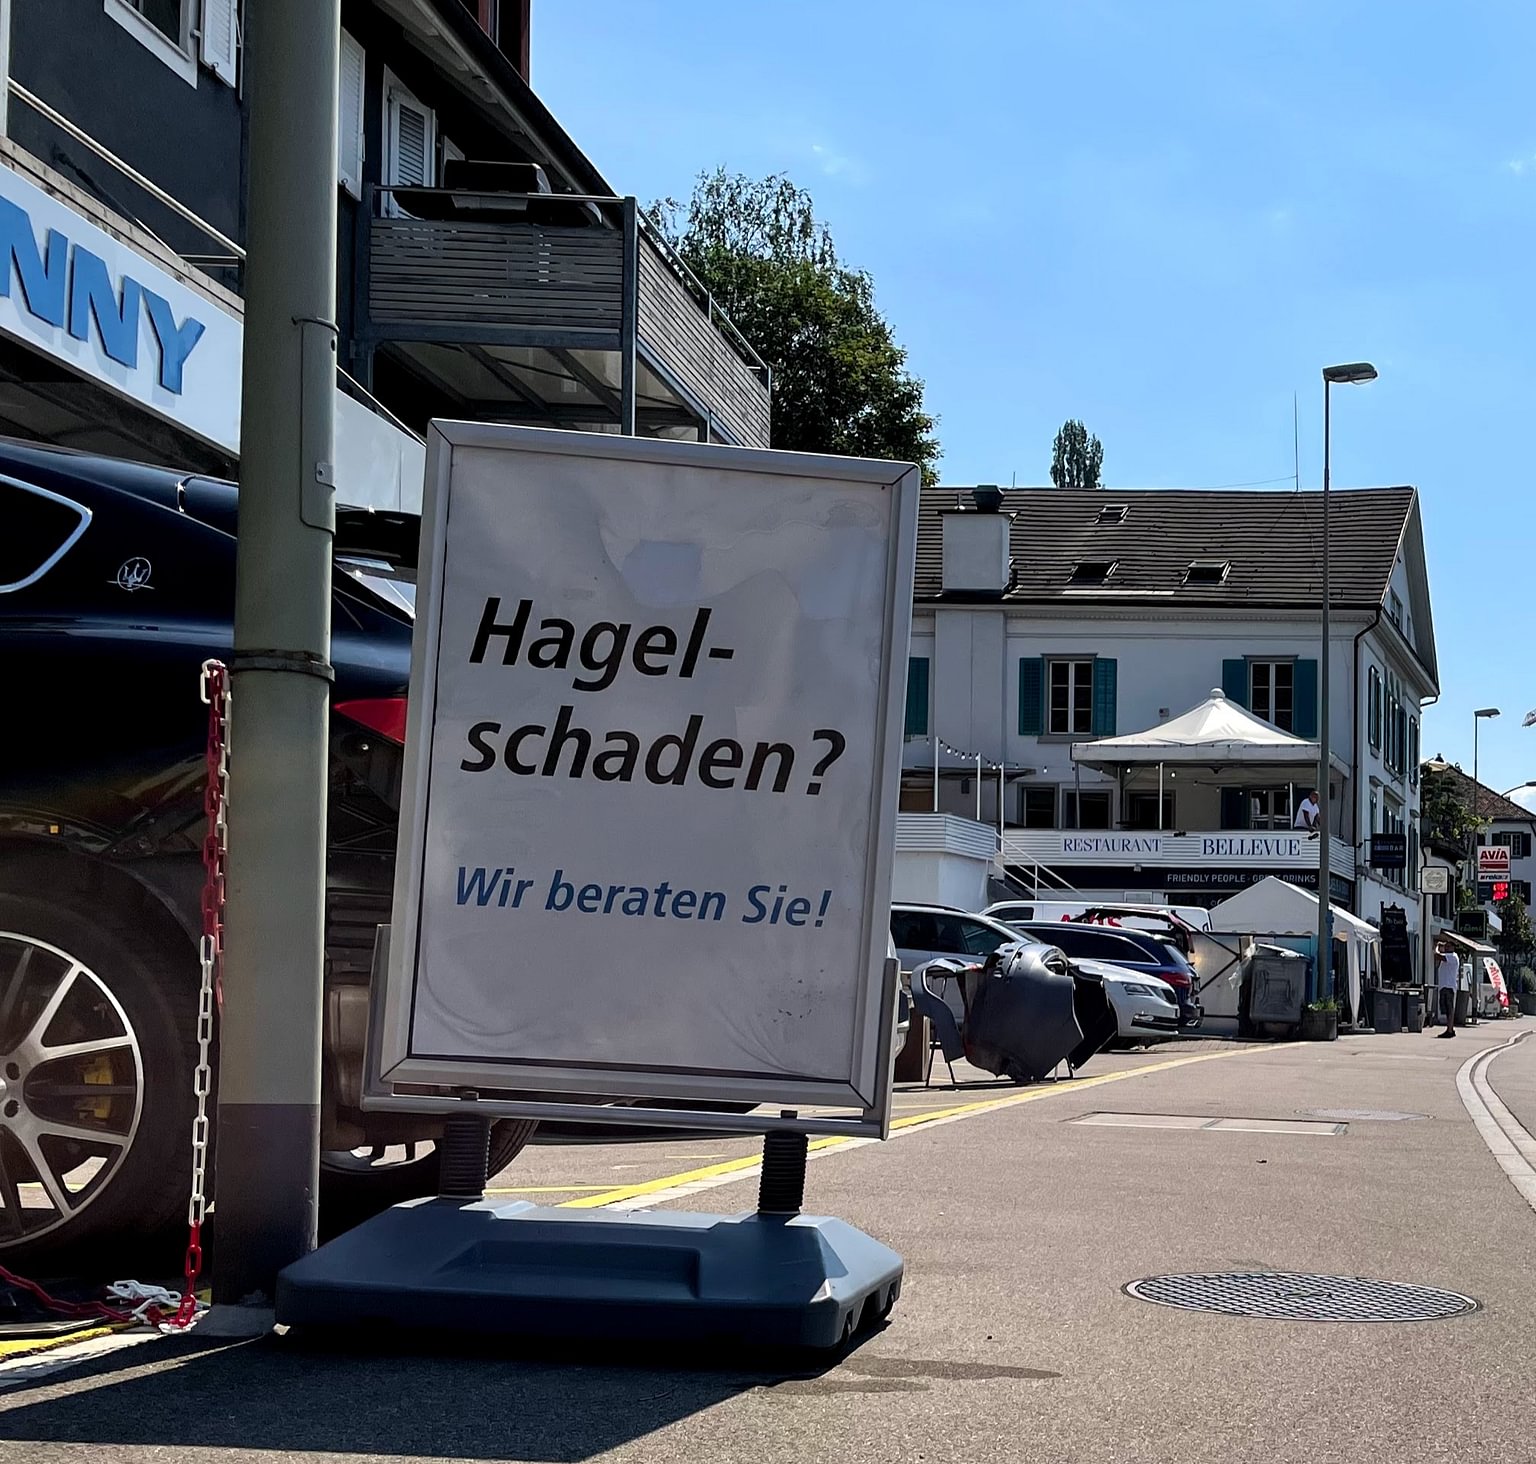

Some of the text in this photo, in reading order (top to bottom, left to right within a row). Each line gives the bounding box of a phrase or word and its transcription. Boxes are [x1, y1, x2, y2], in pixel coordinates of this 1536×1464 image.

[469, 597, 735, 692] Hagel-
[460, 705, 847, 796] schaden?
[1063, 838, 1161, 852] RESTAURANT
[1202, 838, 1301, 856] BELLEVUE
[456, 866, 832, 928] Wir beraten Sie!
[1167, 874, 1209, 883] FRIENDLY
[1211, 874, 1246, 883] PEOPLE
[1282, 875, 1316, 884] DRINKS
